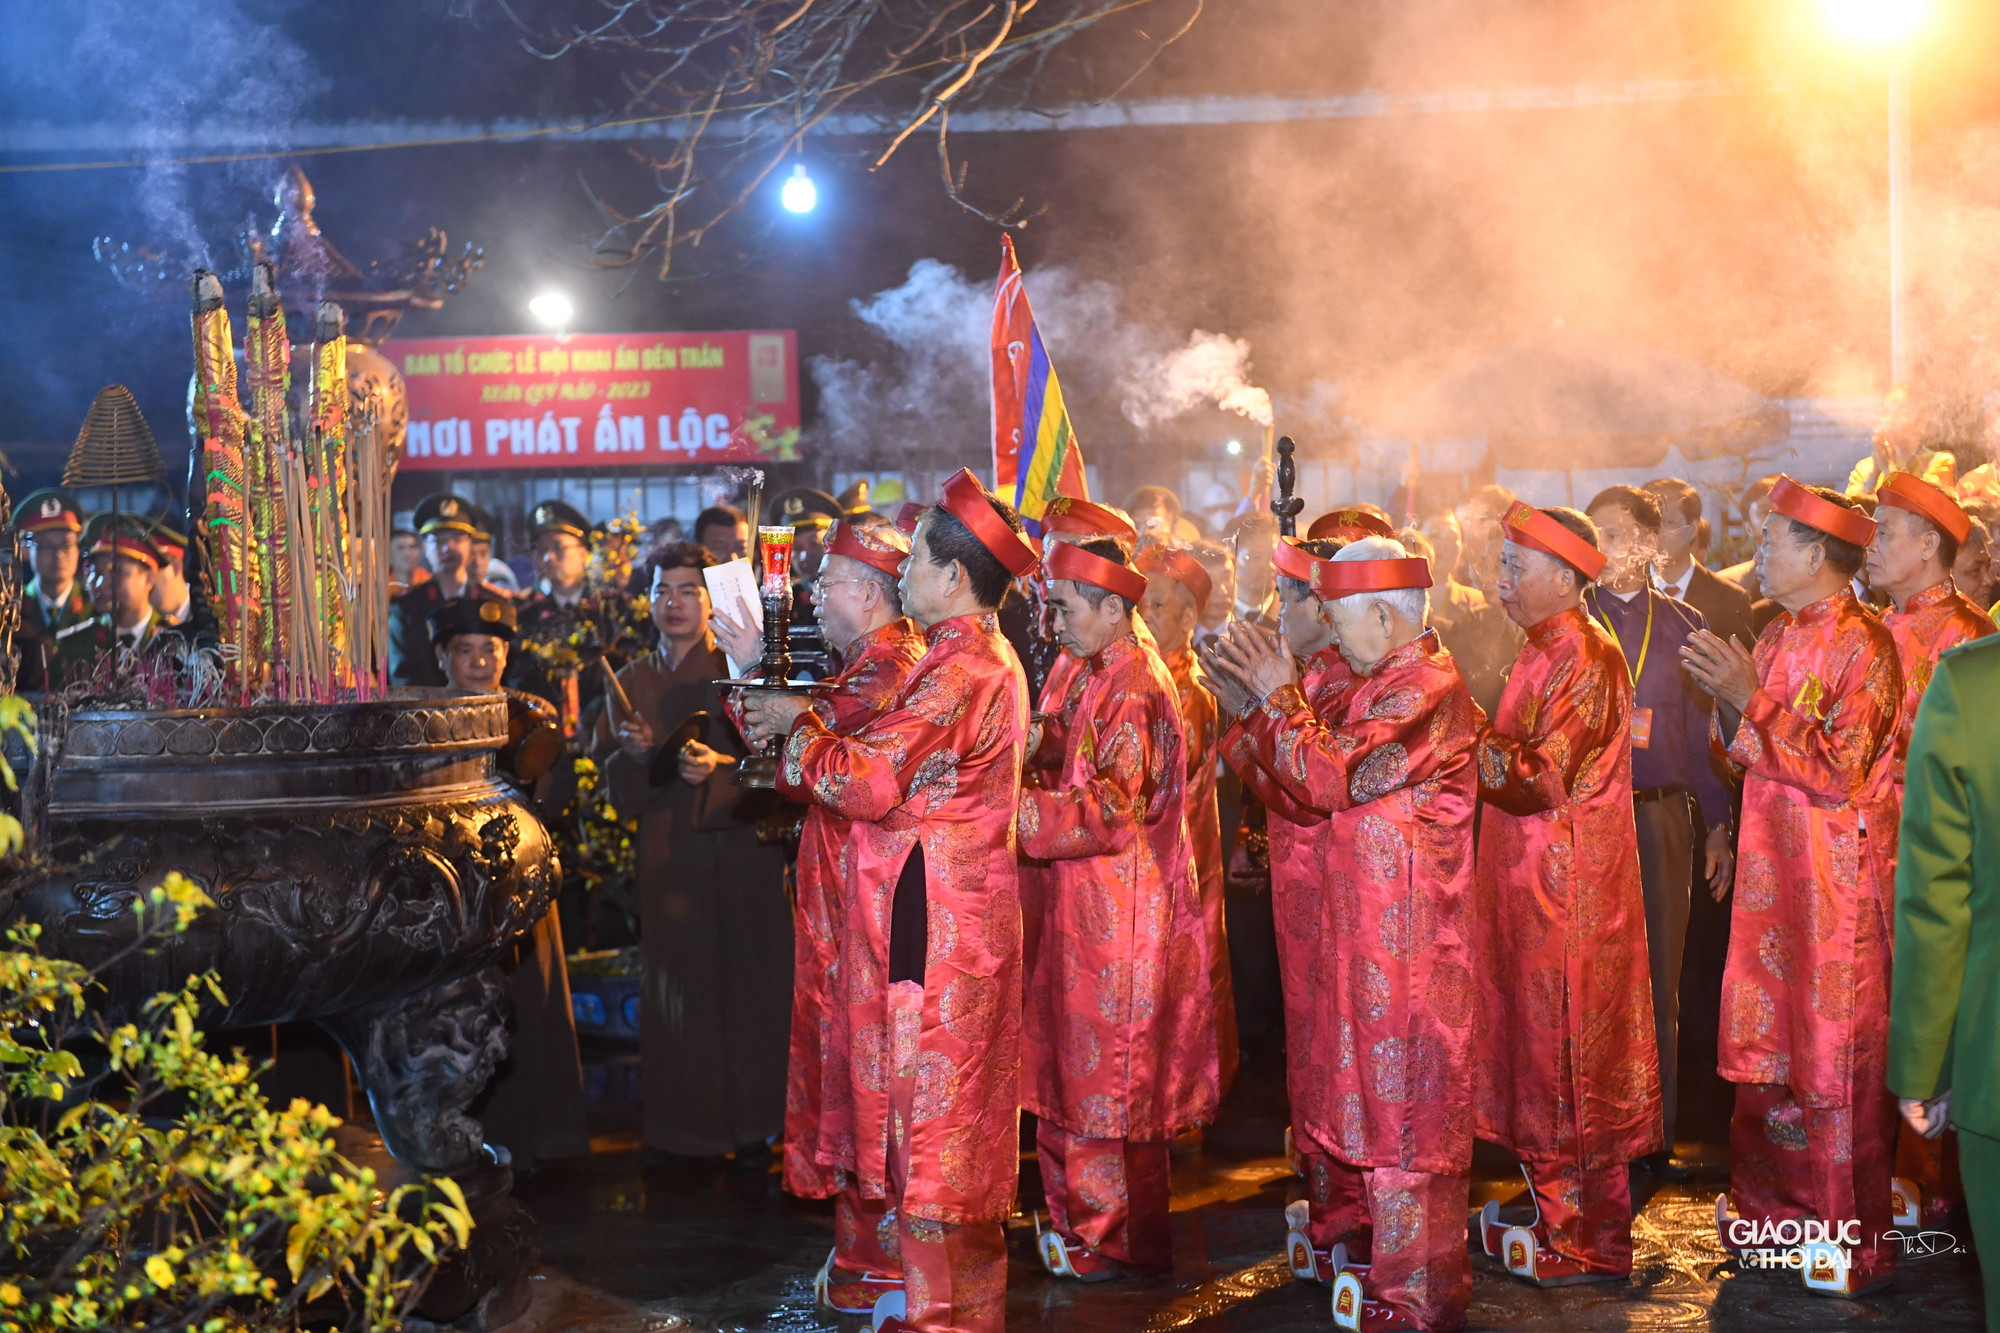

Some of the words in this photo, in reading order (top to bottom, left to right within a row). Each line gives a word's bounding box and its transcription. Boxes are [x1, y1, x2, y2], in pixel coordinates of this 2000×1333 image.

[404, 353, 441, 376] BAN
[467, 349, 514, 375] CHỨC
[571, 349, 612, 372] KHAI
[406, 416, 472, 458] NƠI
[485, 410, 582, 456] PHÁT
[593, 403, 646, 455] ẤN
[658, 407, 732, 457] LỘC
